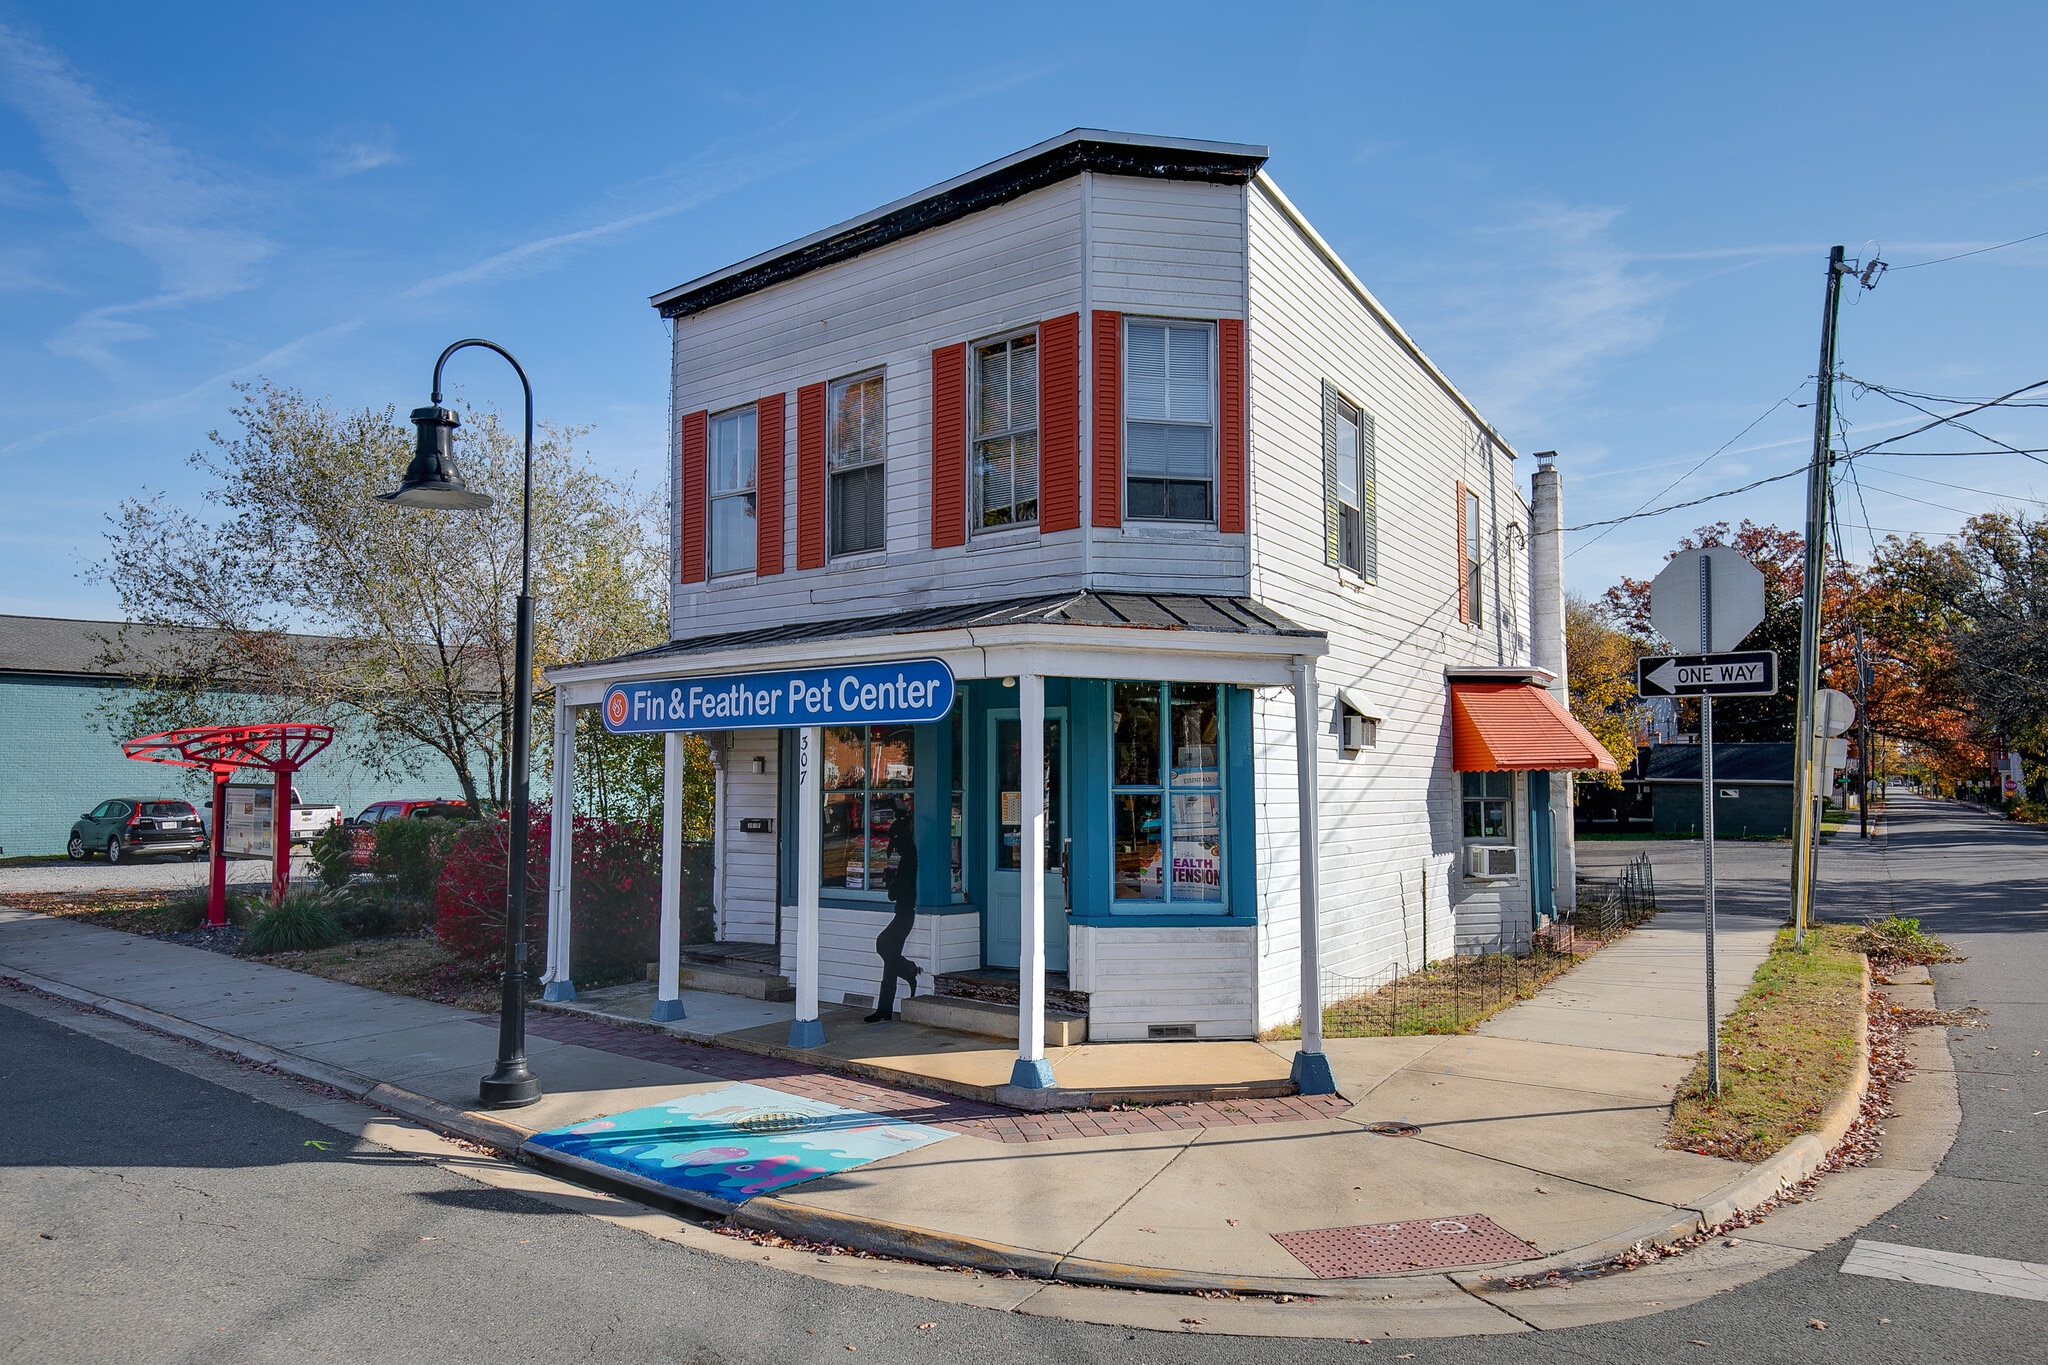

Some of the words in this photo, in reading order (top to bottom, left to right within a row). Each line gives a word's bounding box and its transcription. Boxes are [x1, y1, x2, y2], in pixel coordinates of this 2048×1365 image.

[1678, 668, 1713, 683] ONE
[1720, 664, 1758, 682] WAY
[634, 690, 665, 722] Fin
[668, 688, 686, 720] &
[689, 683, 783, 719] Feather
[788, 678, 833, 714] Pet
[838, 673, 941, 712] Center
[800, 735, 808, 785] 307
[1173, 858, 1213, 868] EALTH
[1156, 867, 1220, 886] ETENSION
